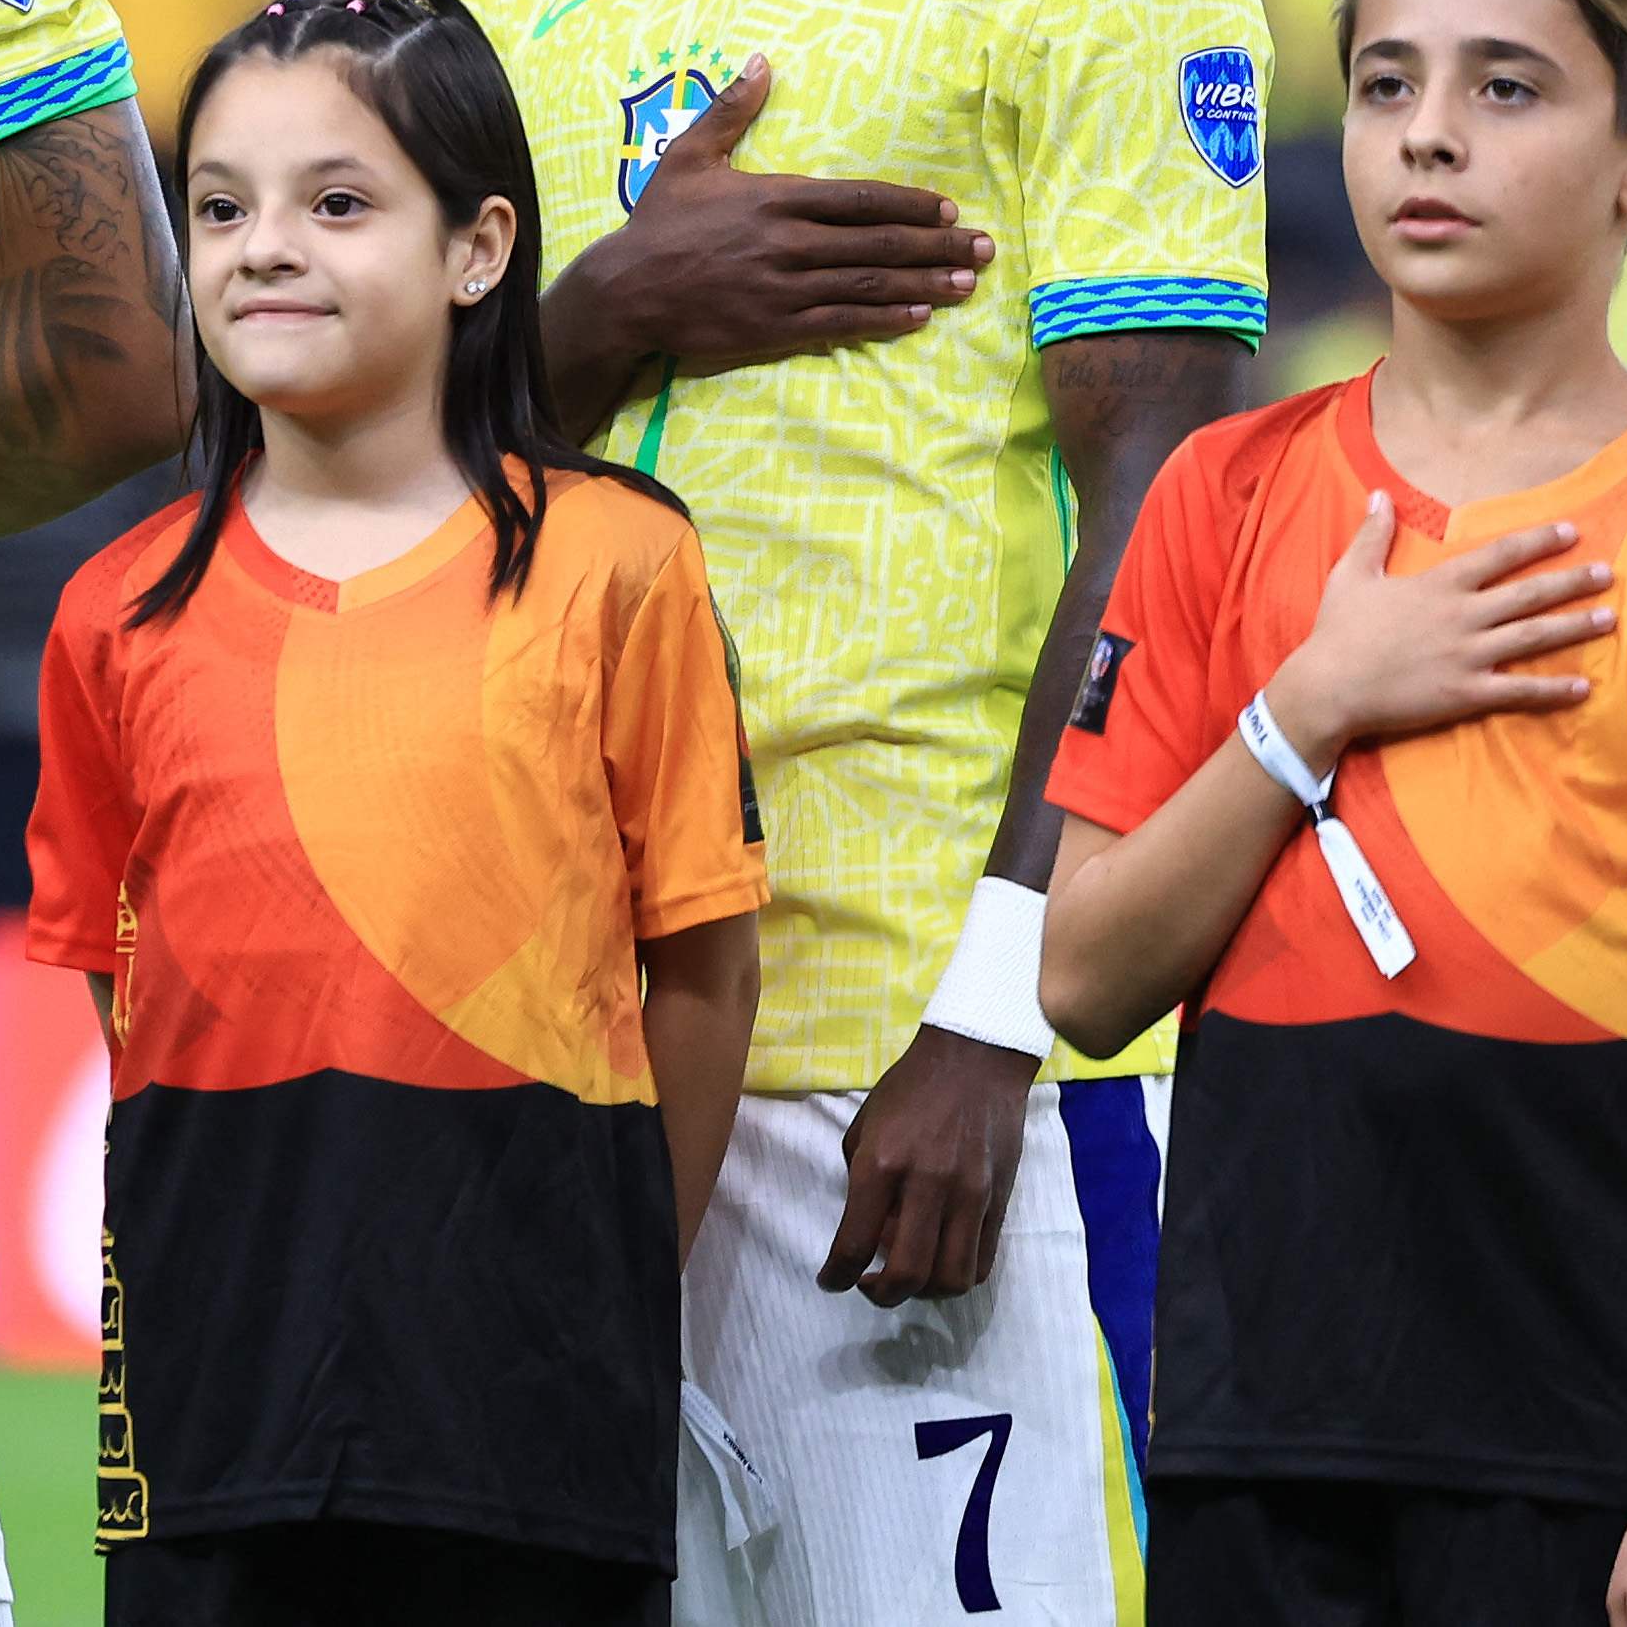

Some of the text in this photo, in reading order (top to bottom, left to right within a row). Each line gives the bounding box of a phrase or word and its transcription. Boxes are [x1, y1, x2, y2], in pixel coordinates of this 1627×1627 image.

[1195, 82, 1257, 108] VIBR
[1195, 108, 1204, 119] O
[914, 1414, 1013, 1614] 7
